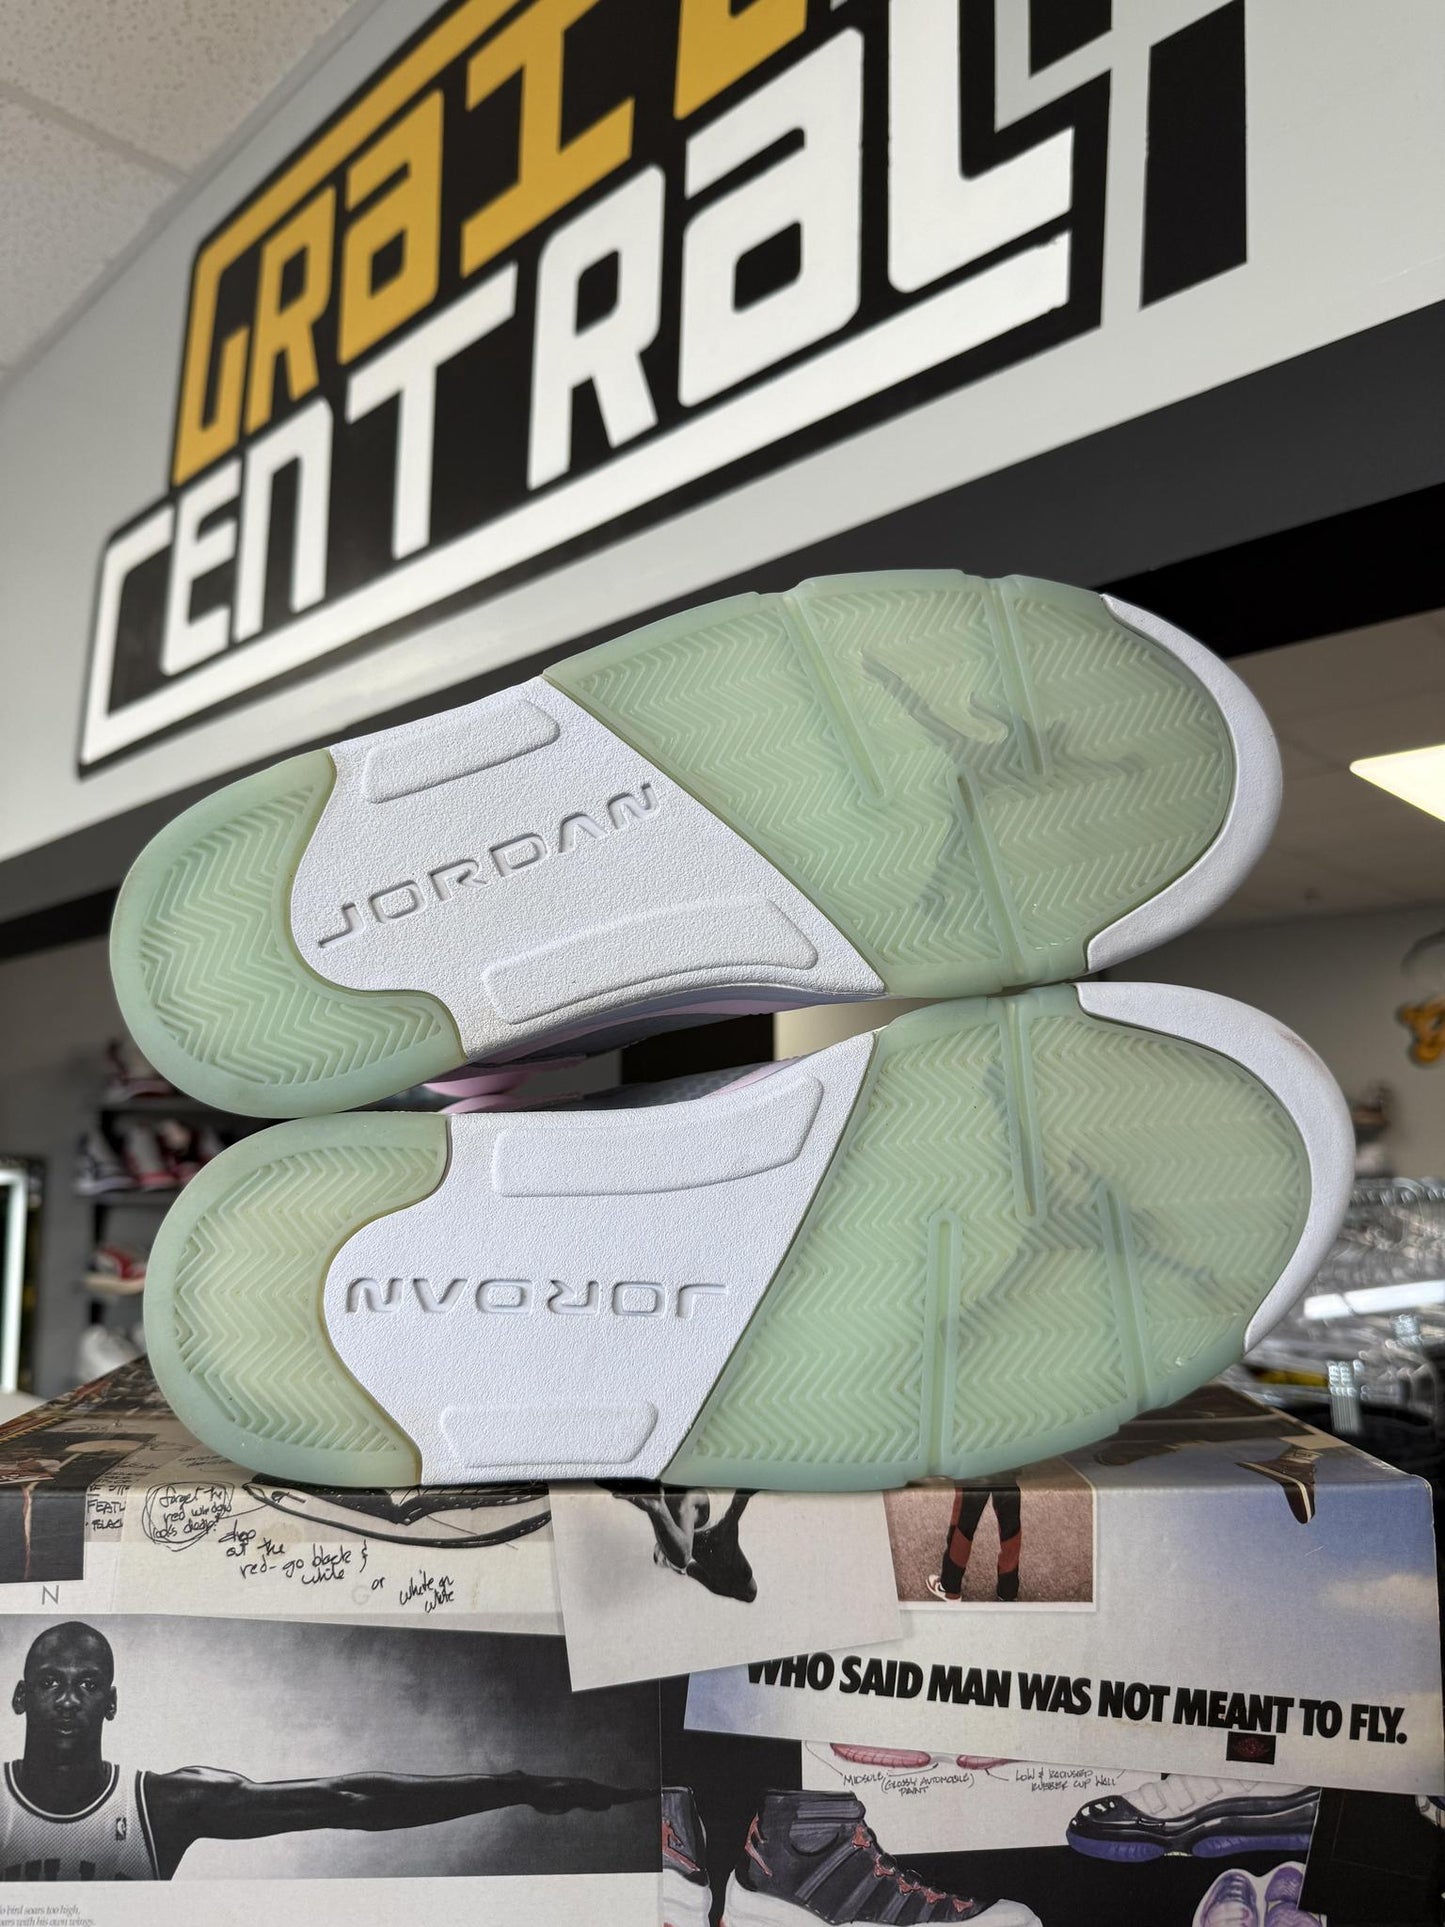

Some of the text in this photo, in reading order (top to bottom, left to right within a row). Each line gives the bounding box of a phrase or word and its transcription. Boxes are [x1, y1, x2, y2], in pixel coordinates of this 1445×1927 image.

[318, 781, 657, 948] JORDAN
[346, 1277, 730, 1319] JORDAN
[311, 1543, 352, 1567] black
[301, 1565, 345, 1585] white
[399, 1568, 434, 1606] white
[42, 1584, 60, 1605] N
[747, 1651, 1407, 1744] WHO SAID MAN WAS NOT MEANT TO FLY.
